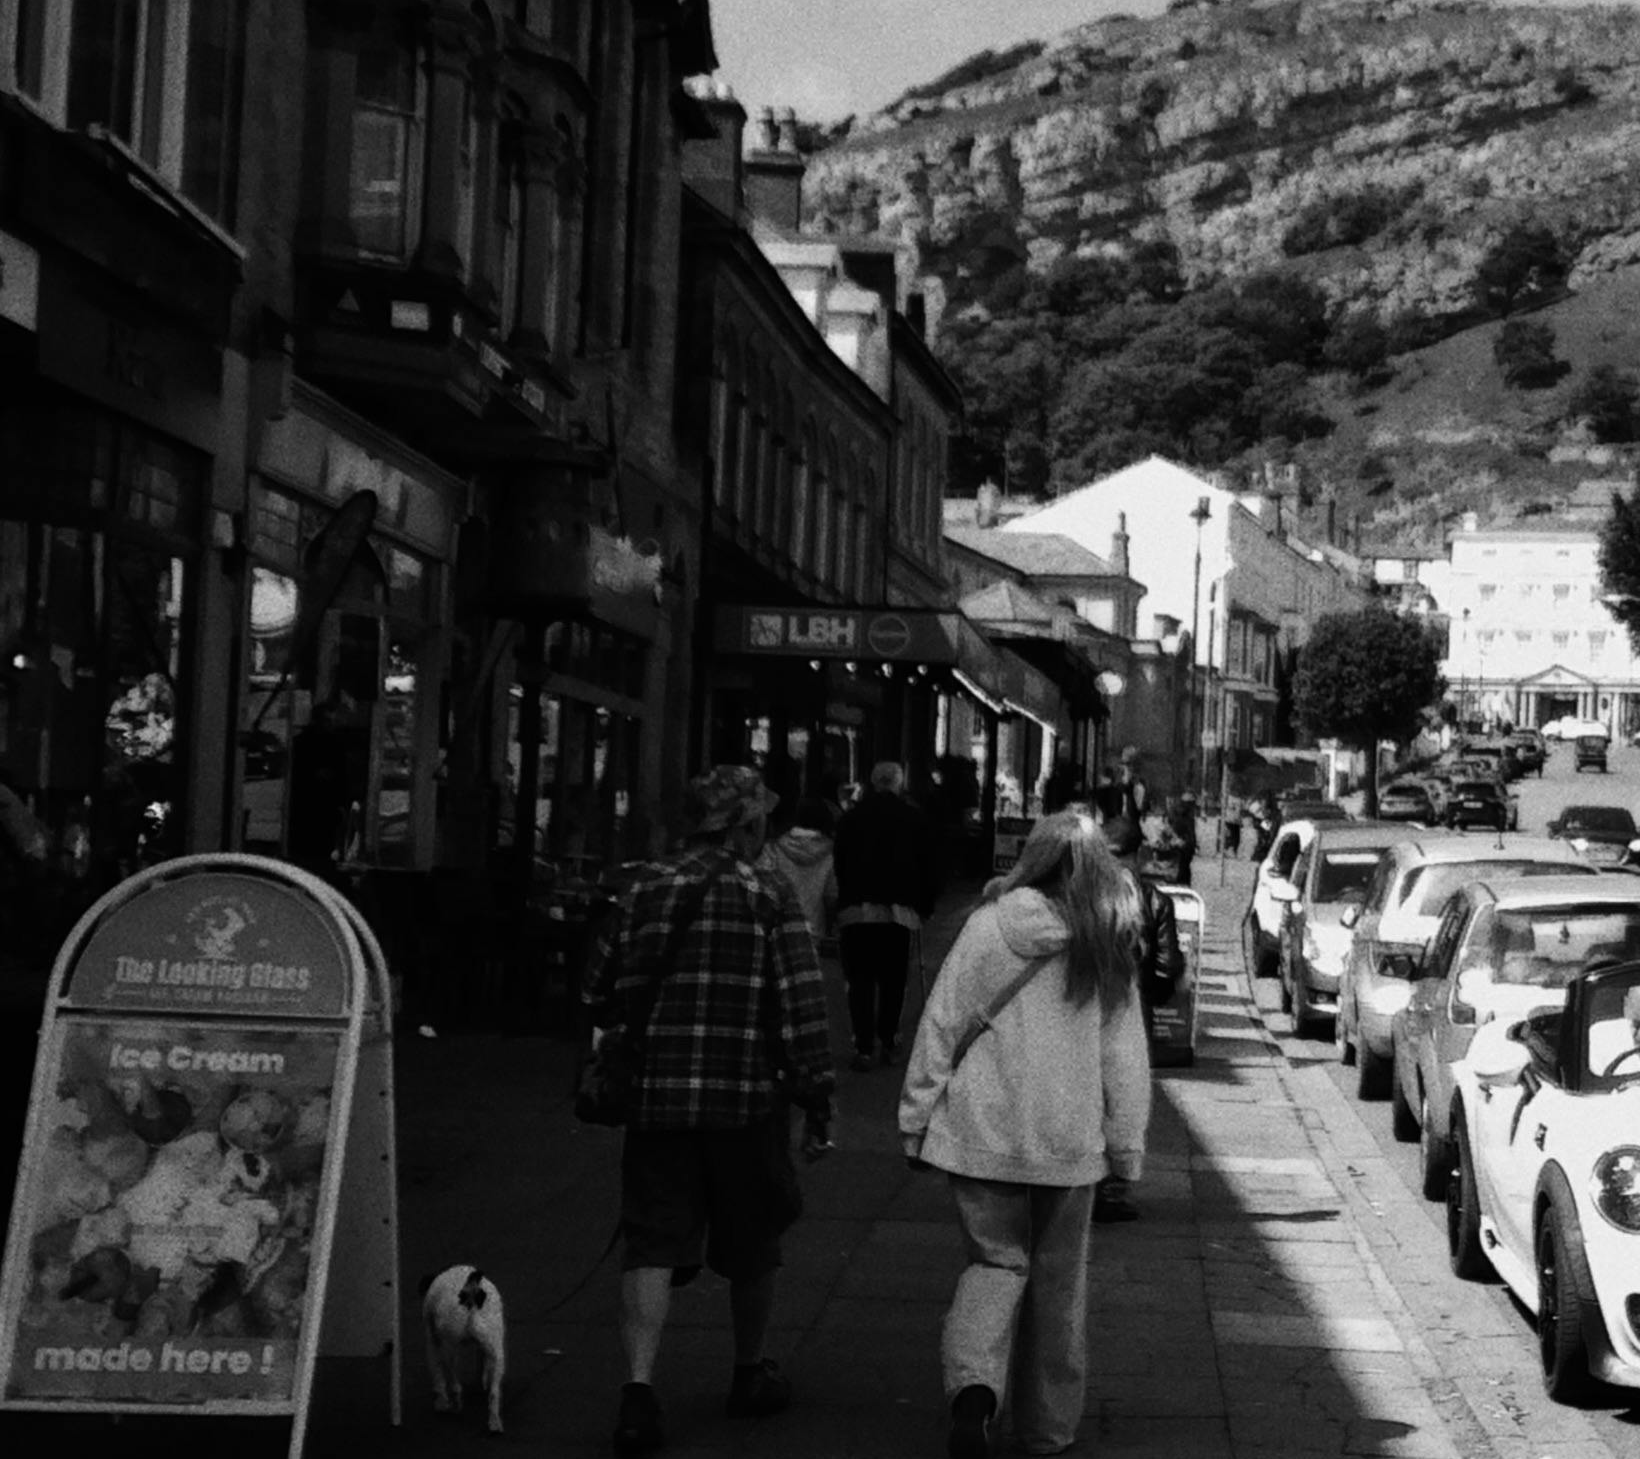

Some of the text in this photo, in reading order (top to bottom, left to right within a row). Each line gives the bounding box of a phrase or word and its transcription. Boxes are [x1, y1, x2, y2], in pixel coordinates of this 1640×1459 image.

[115, 956, 311, 990] The Looking Glass
[109, 1043, 285, 1074] Ice Cream
[34, 1341, 152, 1372] made
